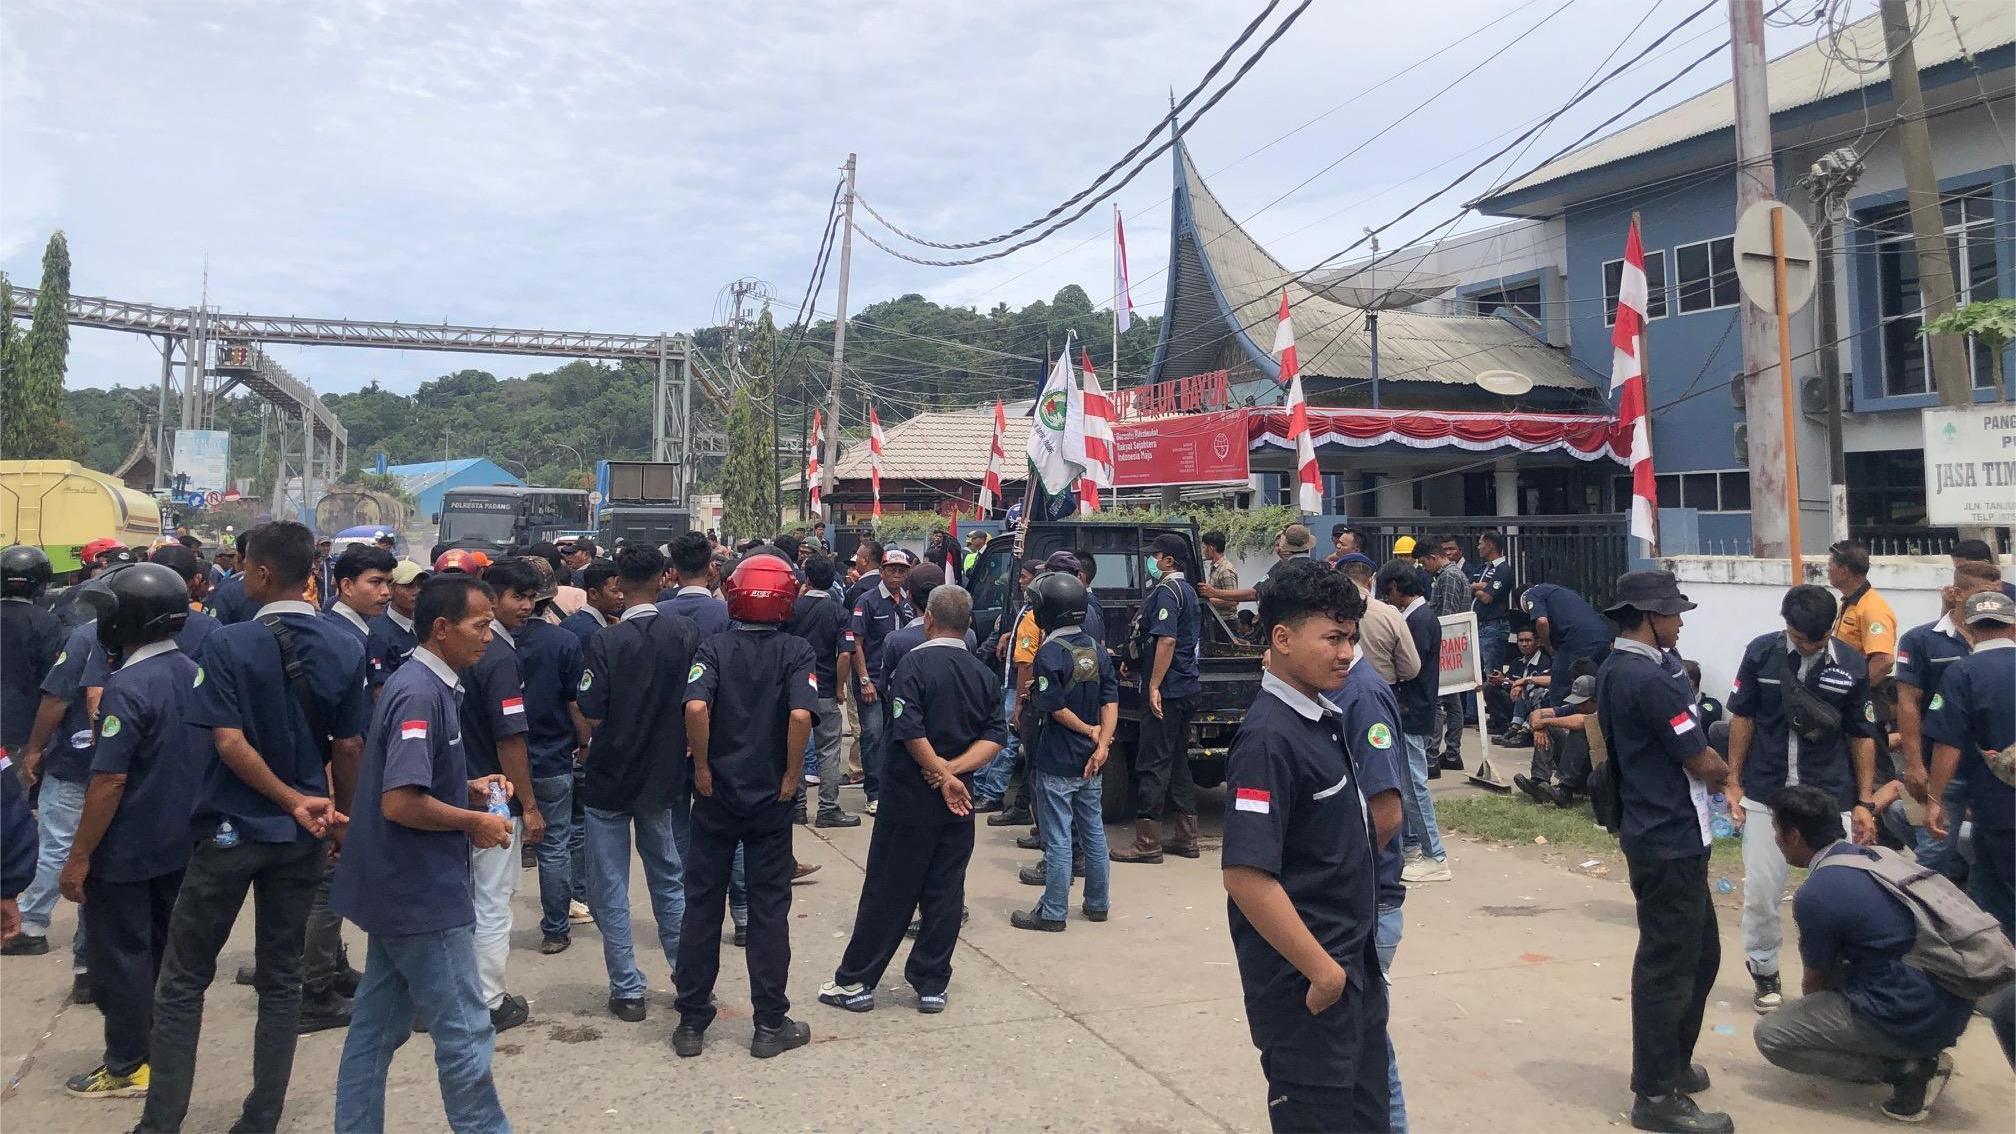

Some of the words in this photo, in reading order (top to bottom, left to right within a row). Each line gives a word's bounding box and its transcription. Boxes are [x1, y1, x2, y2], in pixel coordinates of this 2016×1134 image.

[1180, 369, 1229, 411] BAYUR
[1935, 462, 1977, 495] JASA
[1440, 636, 1468, 654] RANG
